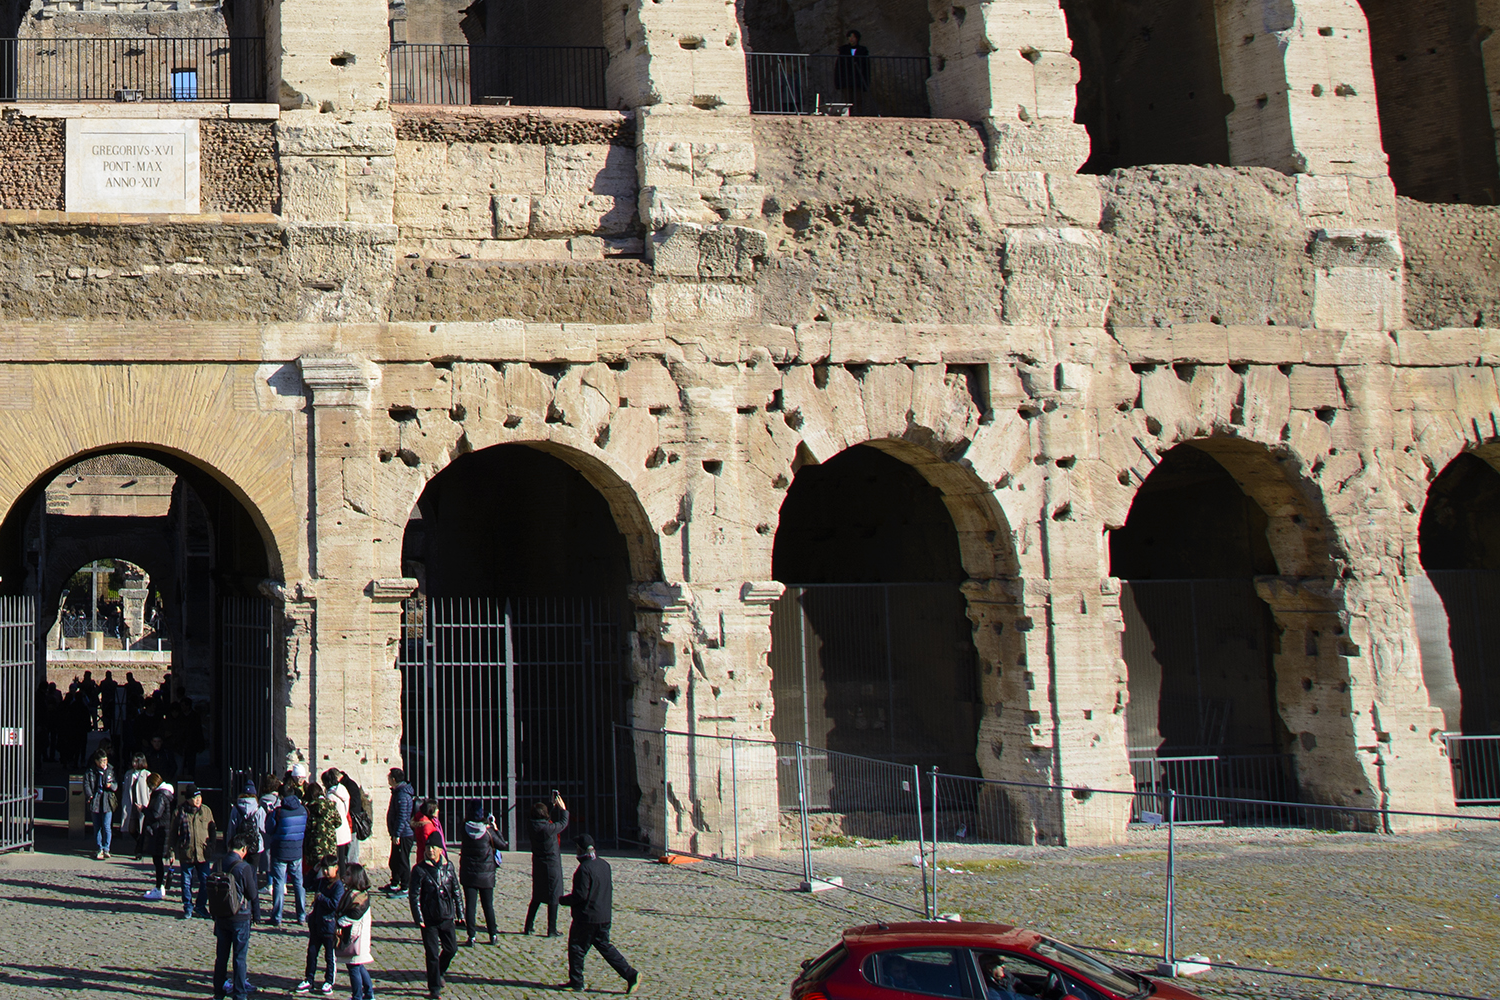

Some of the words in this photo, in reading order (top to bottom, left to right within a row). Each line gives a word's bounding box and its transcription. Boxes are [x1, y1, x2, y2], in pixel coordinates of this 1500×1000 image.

[154, 145, 174, 156] XVI
[103, 161, 131, 172] PONT
[137, 161, 162, 172] MAX
[105, 177, 137, 188] ANNO
[141, 177, 161, 188] XIV
